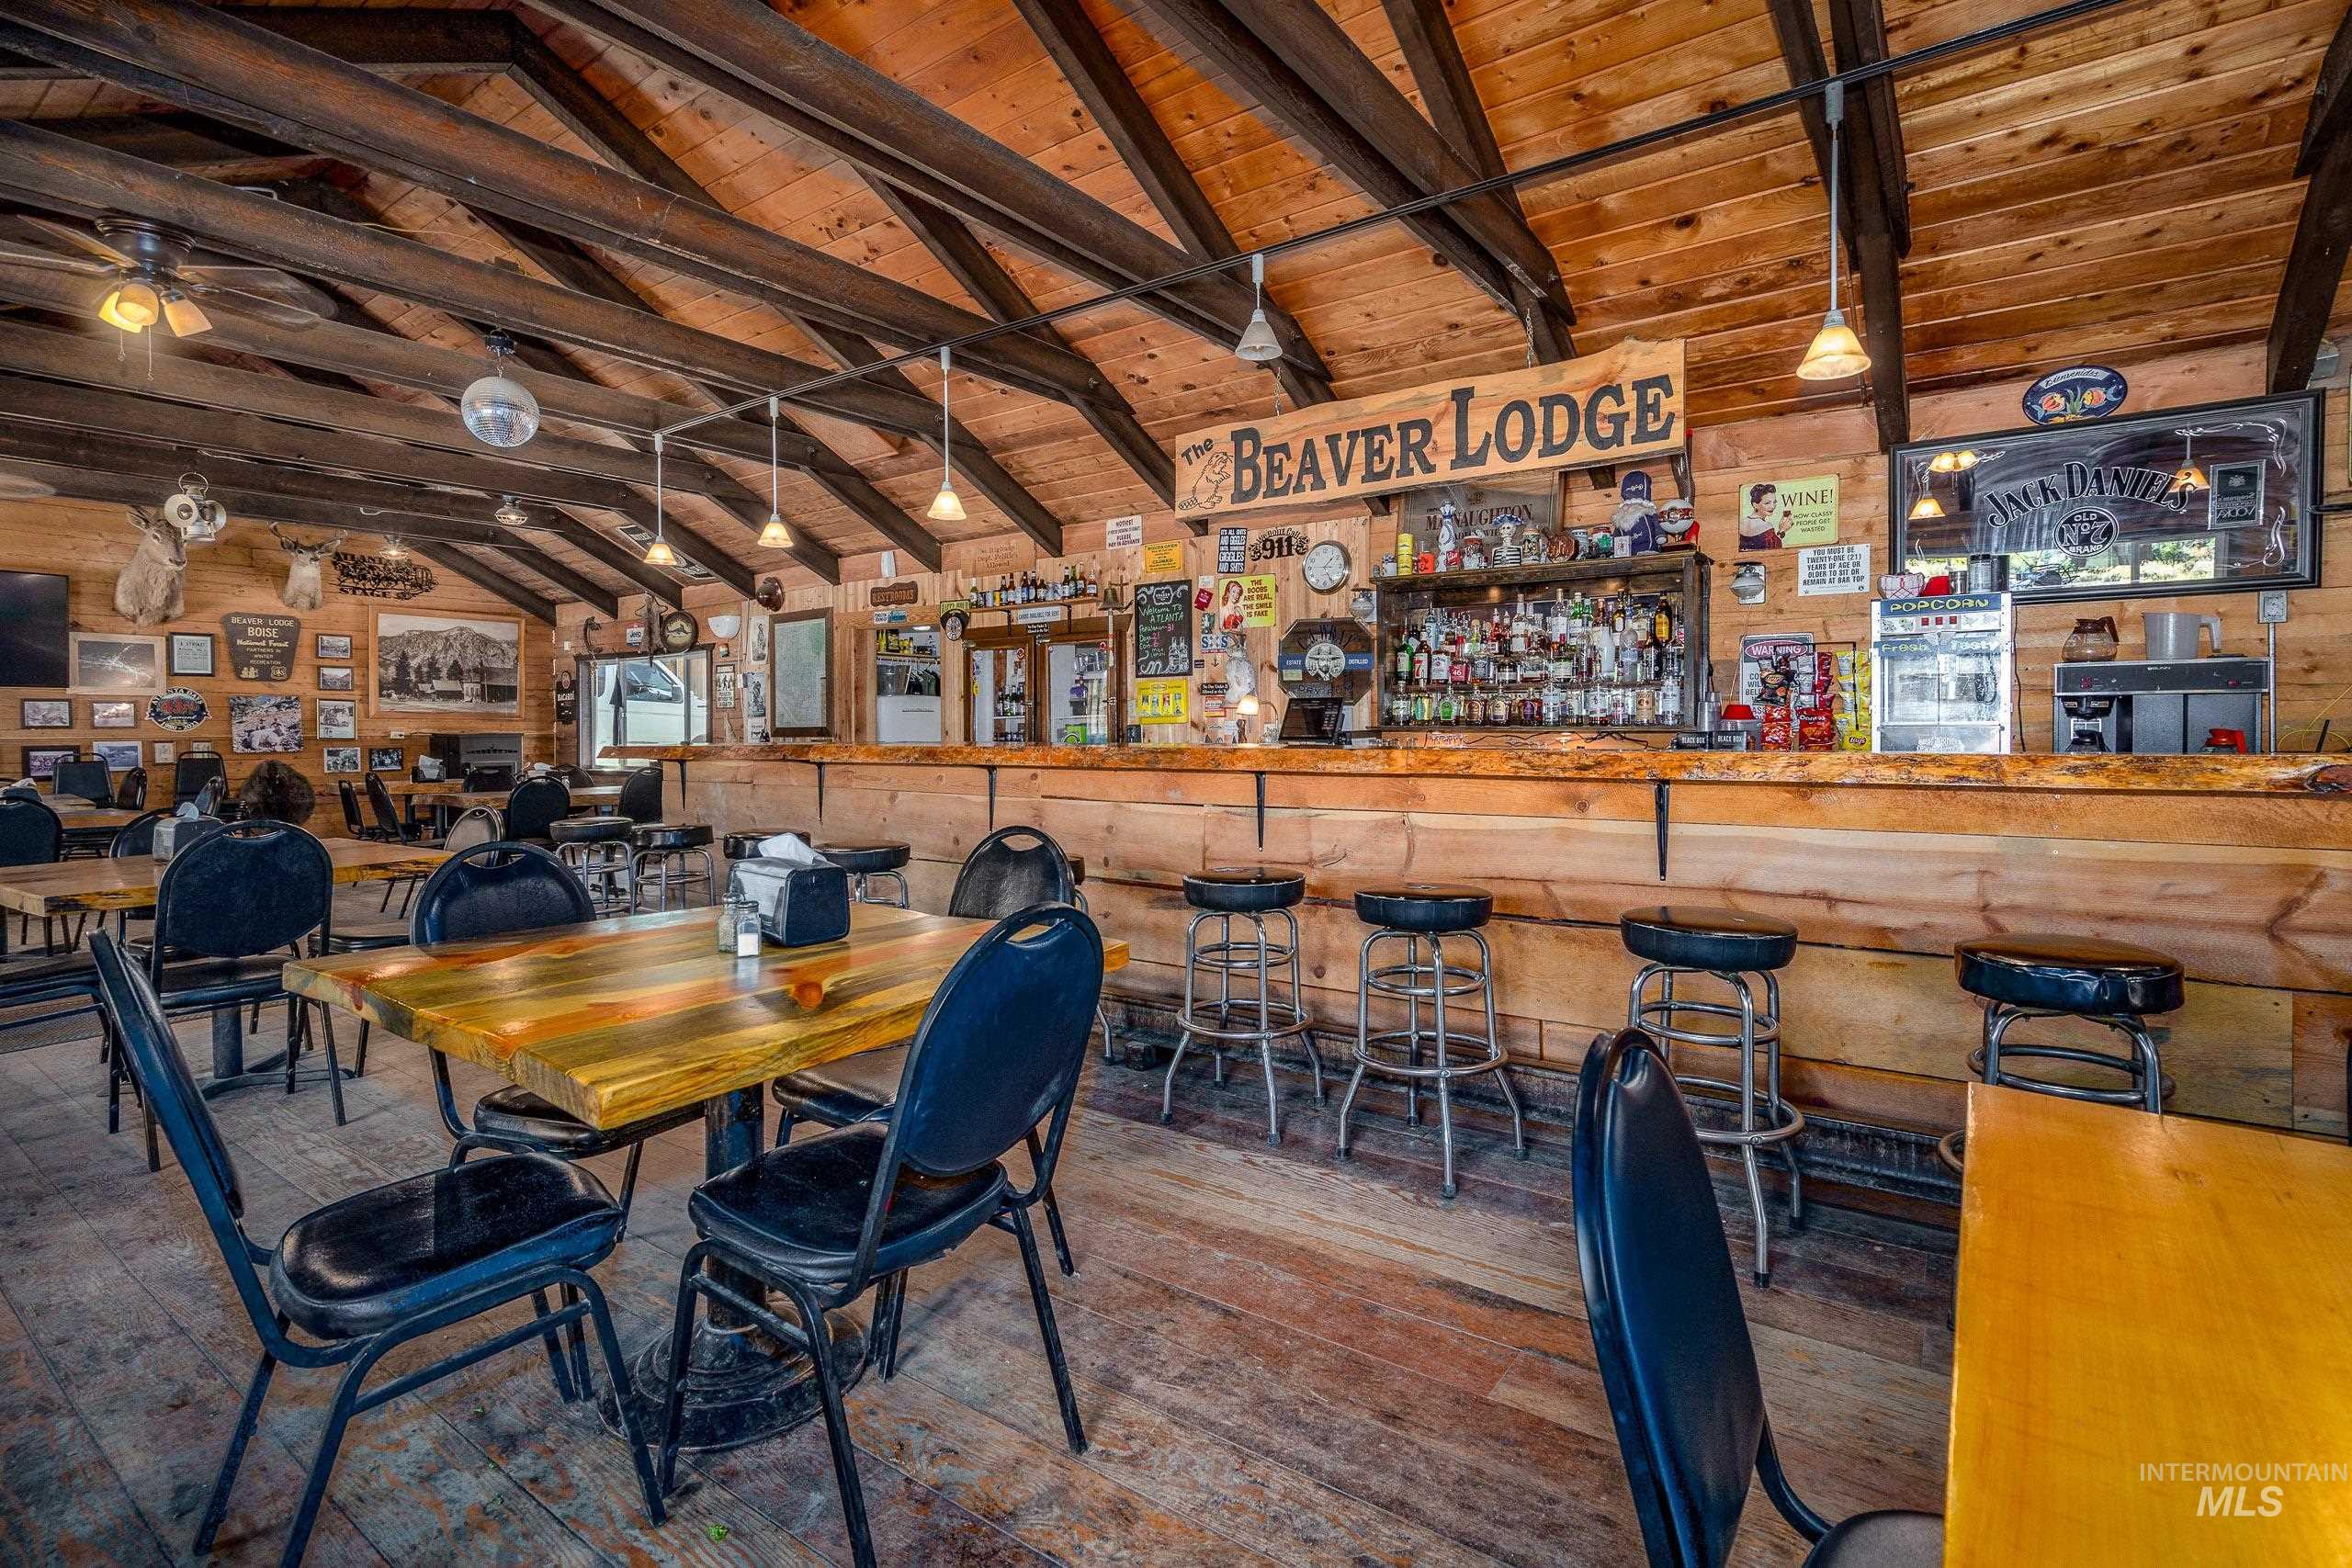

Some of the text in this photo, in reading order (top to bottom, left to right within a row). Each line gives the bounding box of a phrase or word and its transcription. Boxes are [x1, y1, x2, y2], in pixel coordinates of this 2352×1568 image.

[1181, 373, 1677, 505] The BEAVER LODGE
[1781, 489, 1833, 508] WINE!
[1983, 460, 2199, 529] JACK DANIEL'S
[1810, 510, 1833, 518] CLASSY
[2074, 512, 2098, 522] OLD
[1116, 519, 1134, 527] NOTICE!
[1795, 518, 1817, 526] PEOPLE
[1261, 535, 1294, 559] 911
[2069, 544, 2103, 556] BRAND
[1219, 551, 1245, 562] GIGGLES
[1806, 555, 1846, 564] TWENTY-ONE
[1807, 563, 1827, 571] YEARS
[1803, 578, 1826, 586] REMAIN
[339, 587, 391, 598] STAGE
[1247, 586, 1268, 594] BOOBS
[872, 589, 914, 604] RESTROOMS
[1138, 604, 1170, 616] Welcome
[1890, 598, 1989, 613] POPCORN
[231, 616, 265, 626] BEAVER
[1149, 612, 1184, 624] ATLANTA
[247, 626, 279, 638] BOISE
[236, 638, 289, 648] National Forest
[1882, 643, 1928, 652] Fresh
[1751, 644, 1802, 656] WARNING
